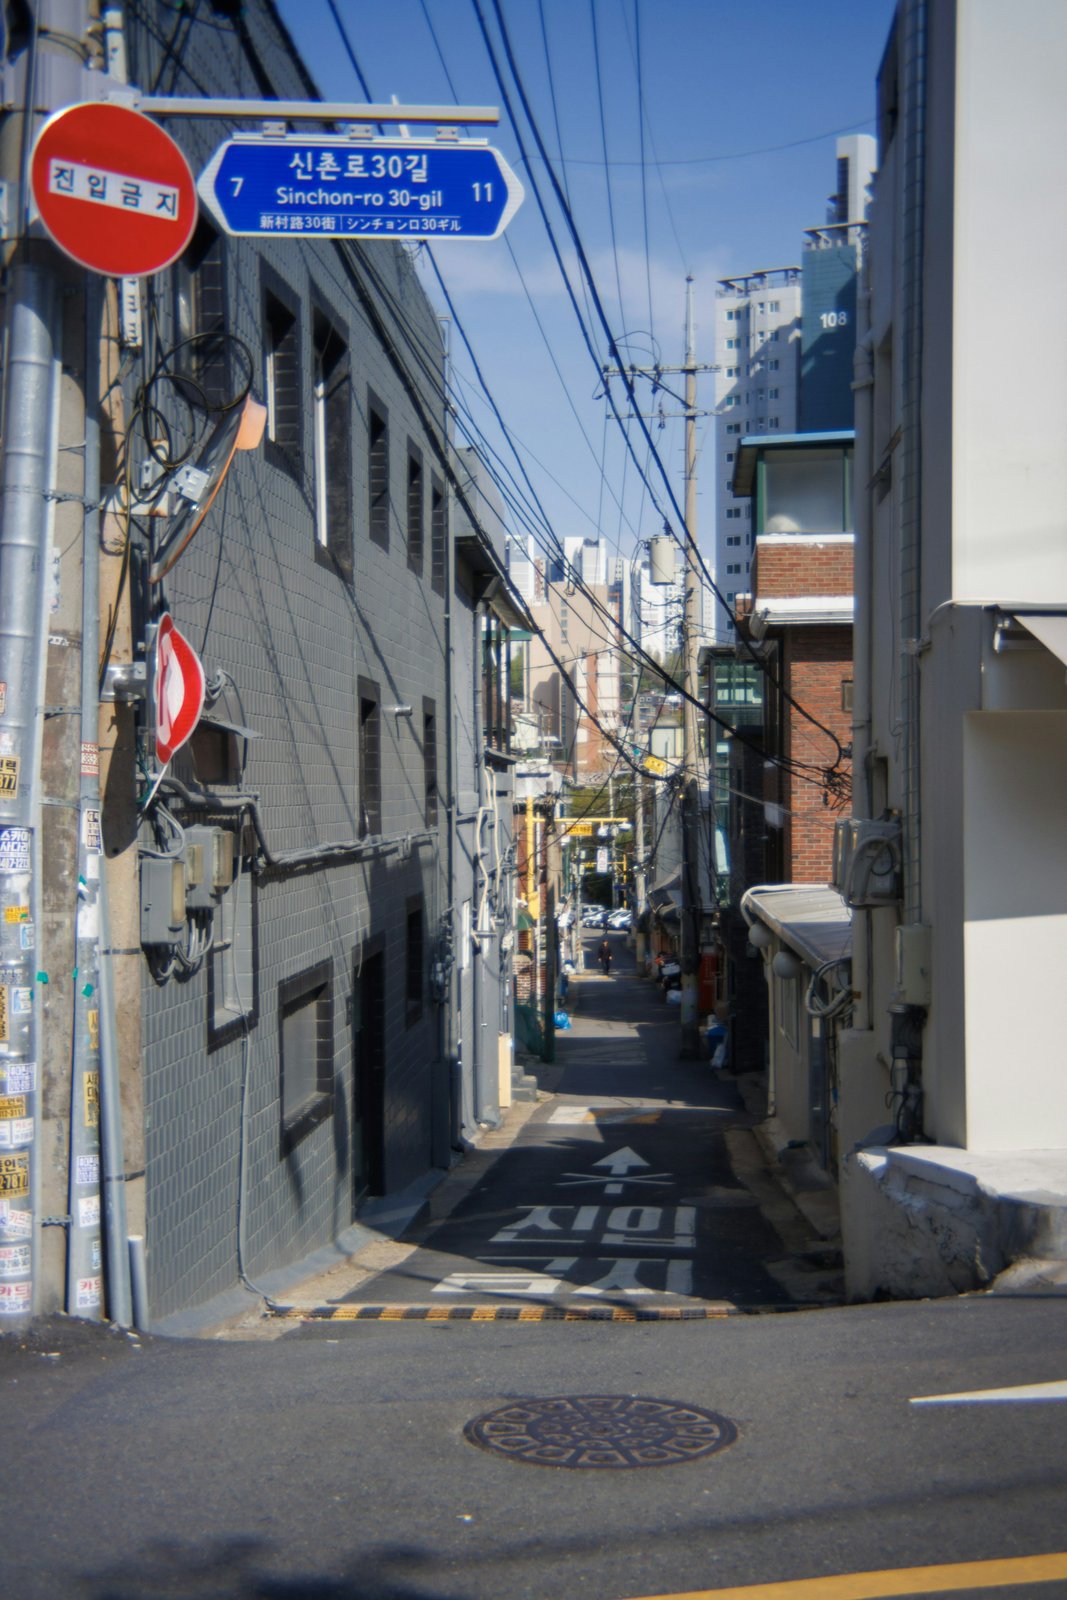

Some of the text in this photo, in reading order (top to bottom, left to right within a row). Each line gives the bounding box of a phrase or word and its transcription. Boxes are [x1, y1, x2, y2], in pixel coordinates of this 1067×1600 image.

[288, 151, 428, 183] 신촌로30길
[53, 166, 177, 217] 진입금지
[229, 177, 244, 198] 7
[276, 186, 443, 211] Sinchon-ro 30-gil
[472, 182, 493, 203] 11
[820, 311, 847, 328] 108
[488, 1205, 697, 1248] 진입
[430, 1256, 694, 1295] 금지
